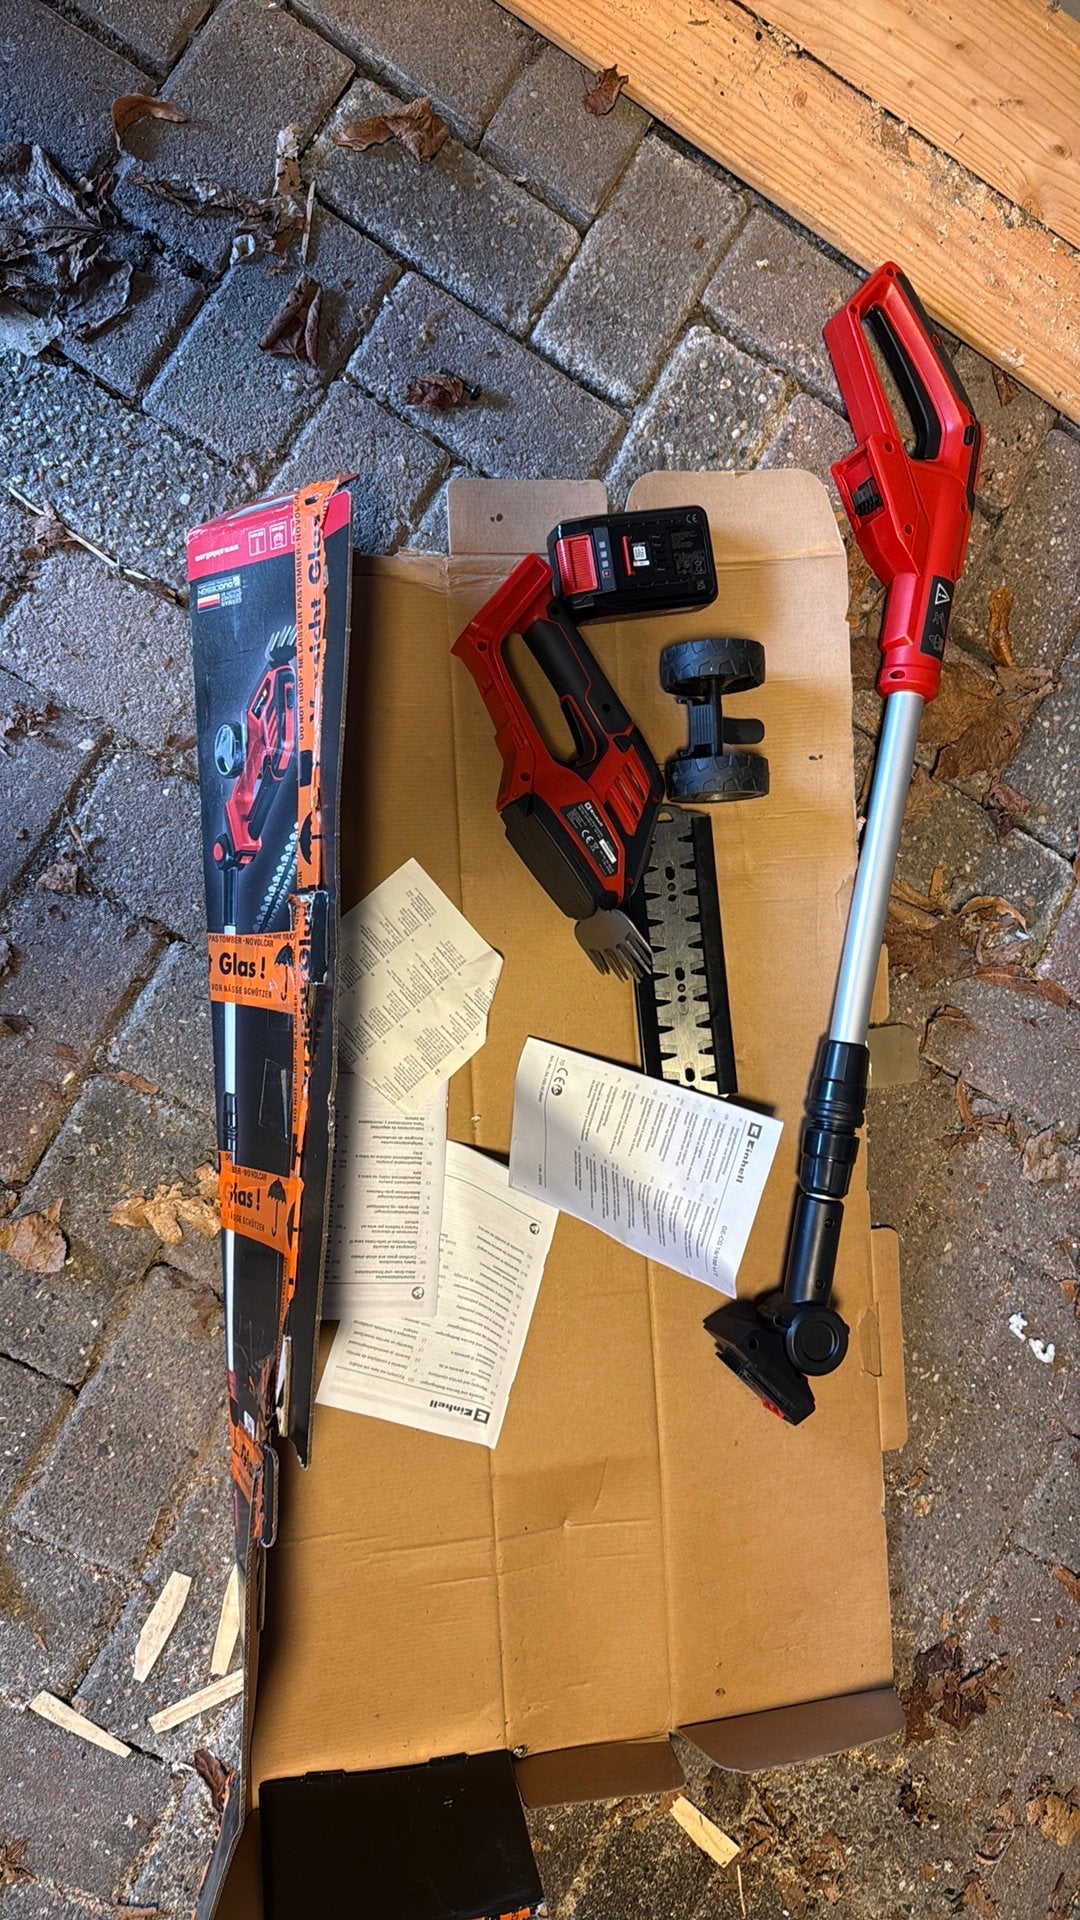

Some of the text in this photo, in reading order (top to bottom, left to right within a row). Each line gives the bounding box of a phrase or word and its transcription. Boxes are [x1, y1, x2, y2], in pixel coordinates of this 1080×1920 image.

[297, 655, 304, 669] NE
[219, 952, 266, 979] Glas !
[211, 983, 222, 992] VOR
[223, 983, 242, 994] NÄSSE
[735, 1139, 754, 1183] Einhell
[429, 1399, 473, 1416] Einhell
